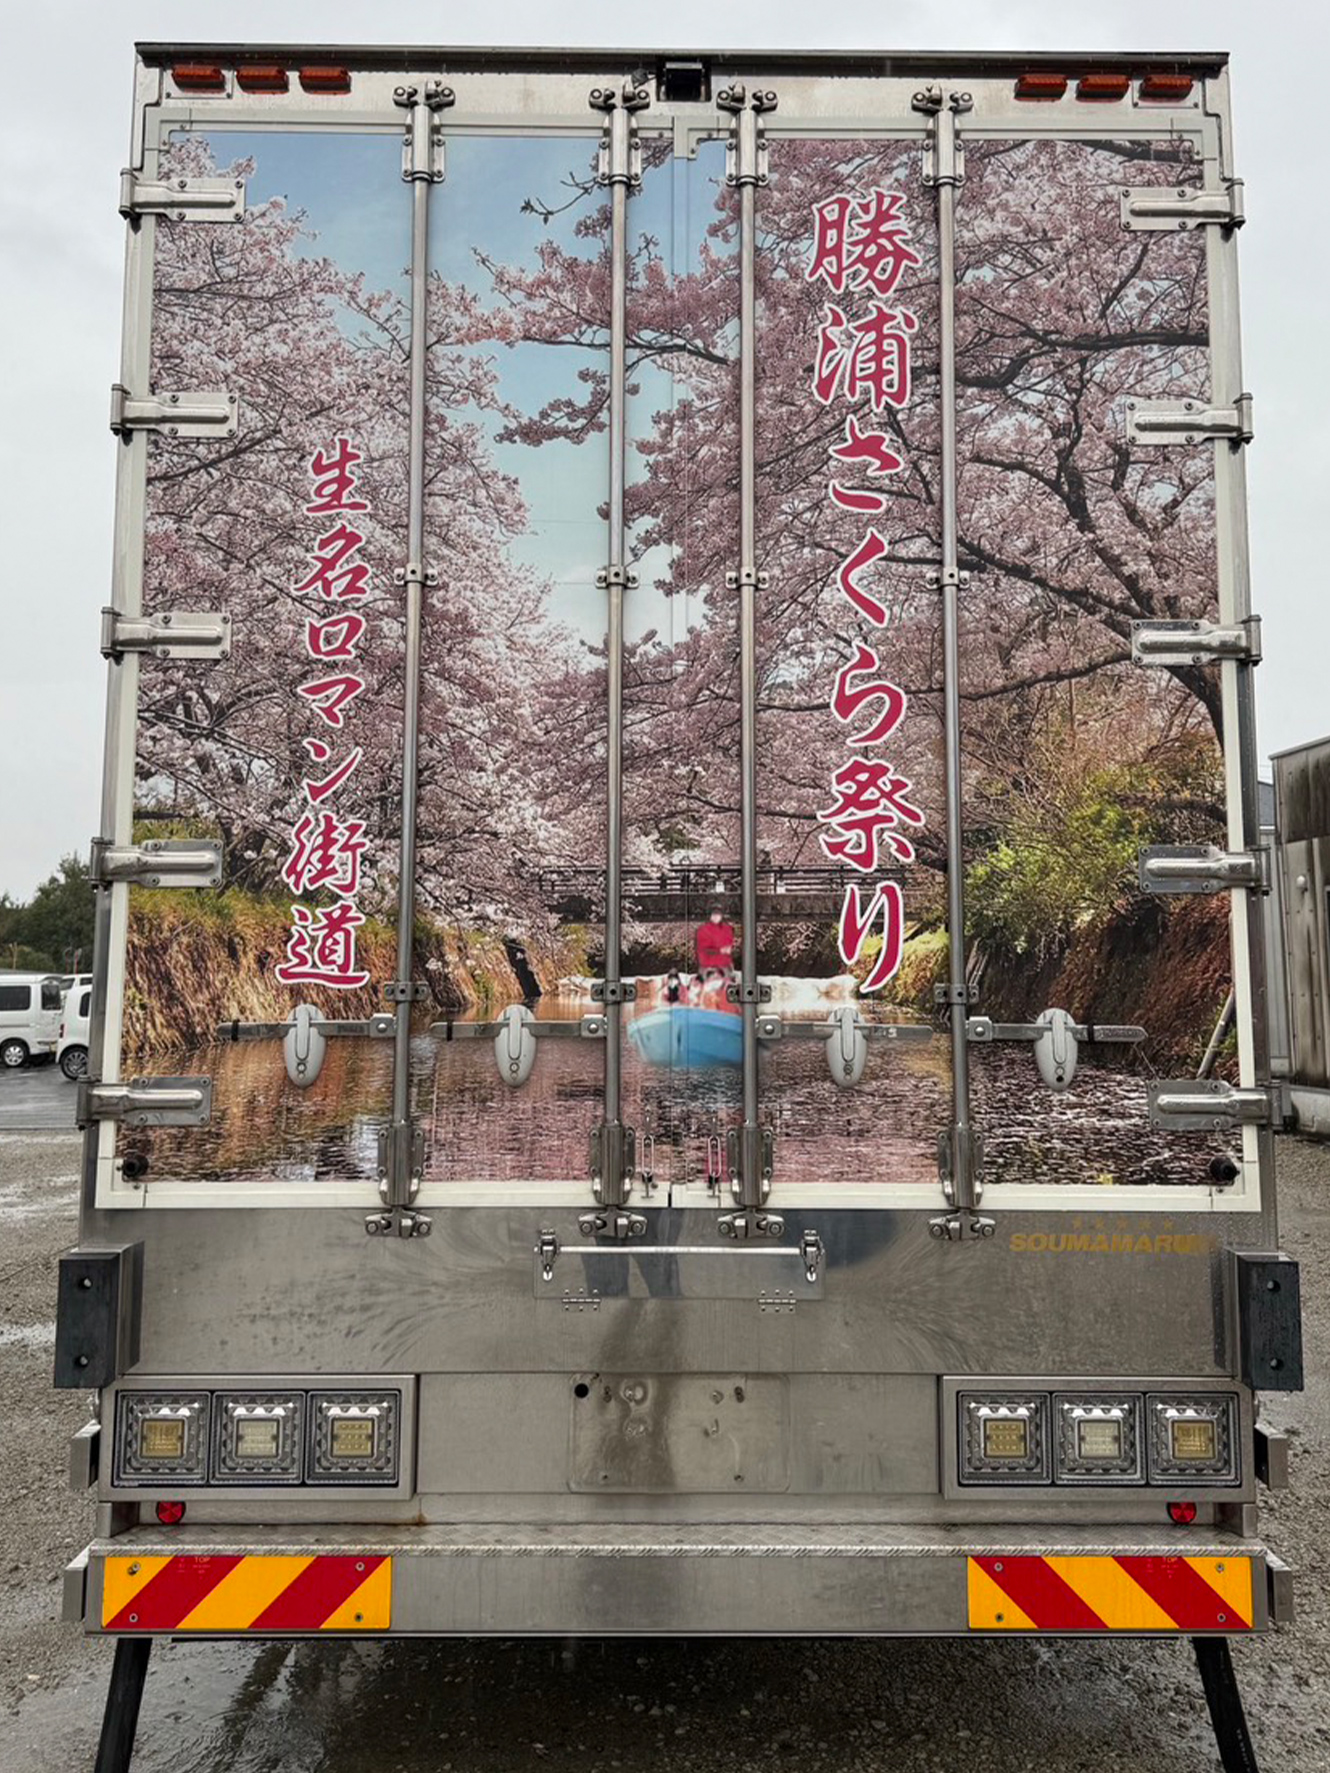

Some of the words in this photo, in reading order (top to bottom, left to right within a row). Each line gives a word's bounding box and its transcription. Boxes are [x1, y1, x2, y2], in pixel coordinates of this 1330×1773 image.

[275, 436, 372, 988] 生名ロマン街道
[808, 189, 924, 995] 勝浦さくら祭り
